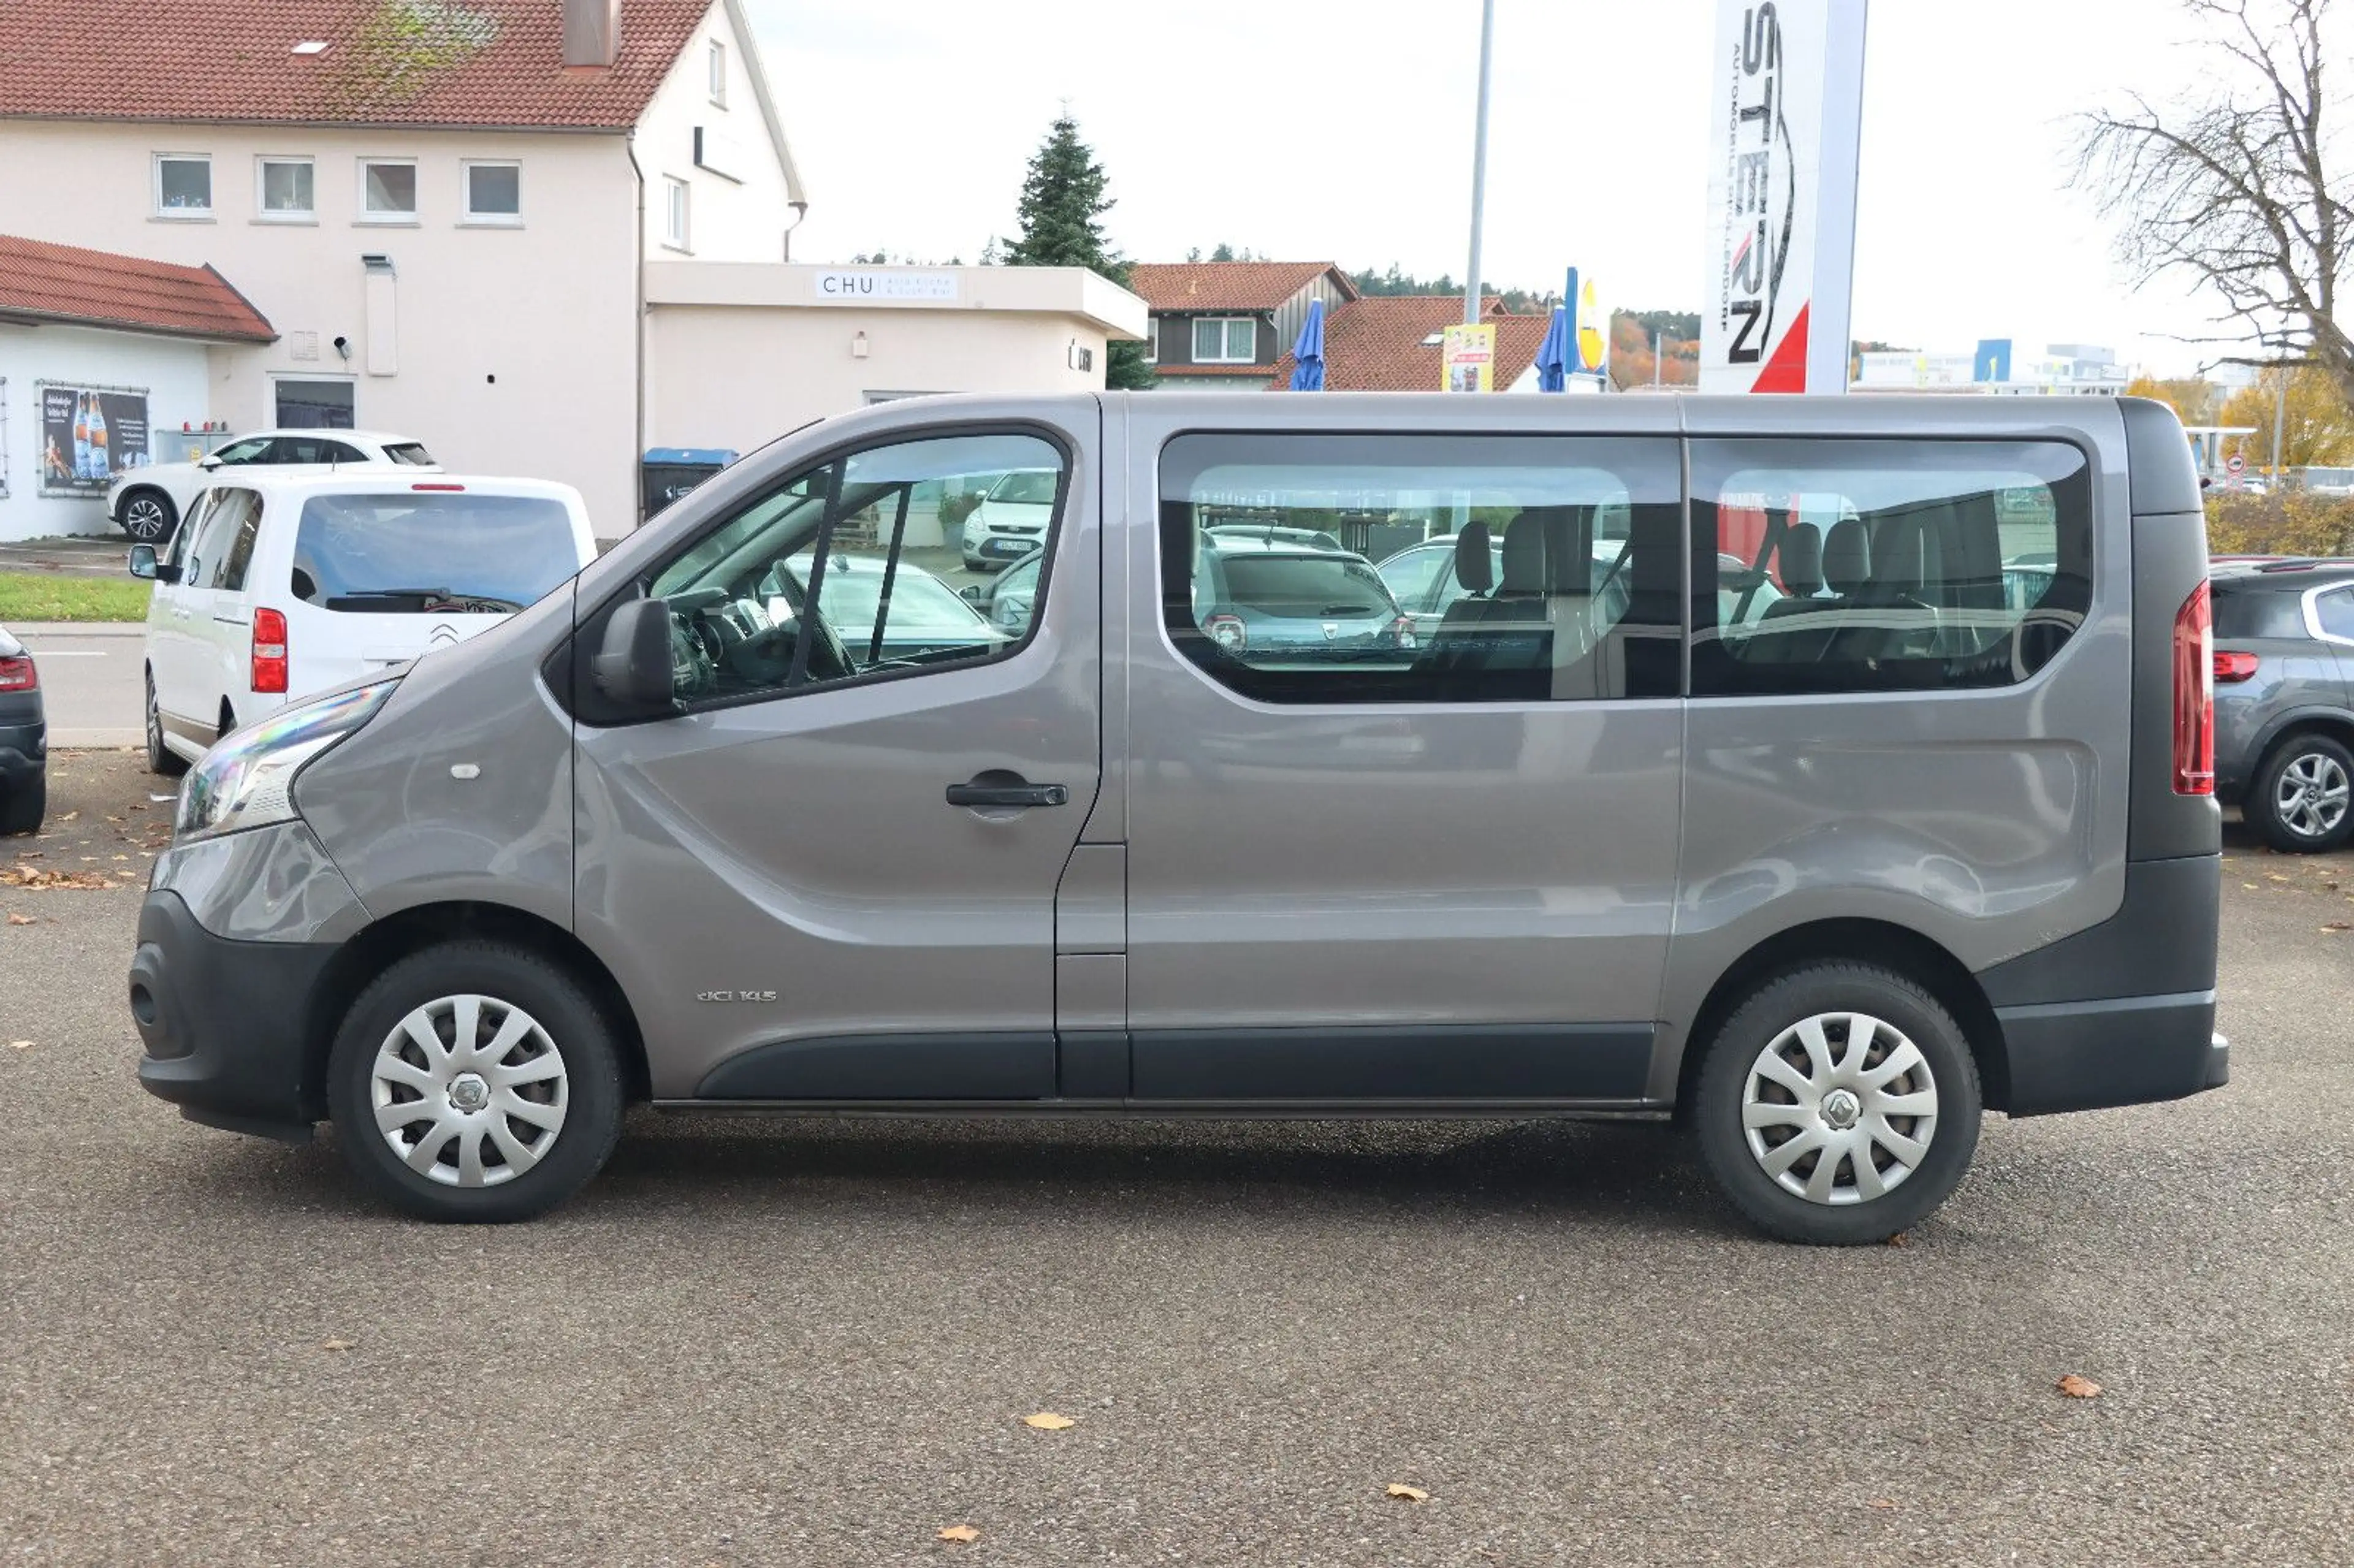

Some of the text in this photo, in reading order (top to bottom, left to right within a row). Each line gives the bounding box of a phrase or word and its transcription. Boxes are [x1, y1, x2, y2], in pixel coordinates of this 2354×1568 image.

[1726, 42, 1740, 178] AUTOMOBILE
[1729, 1, 1777, 364] STERN
[823, 276, 872, 294] CHU
